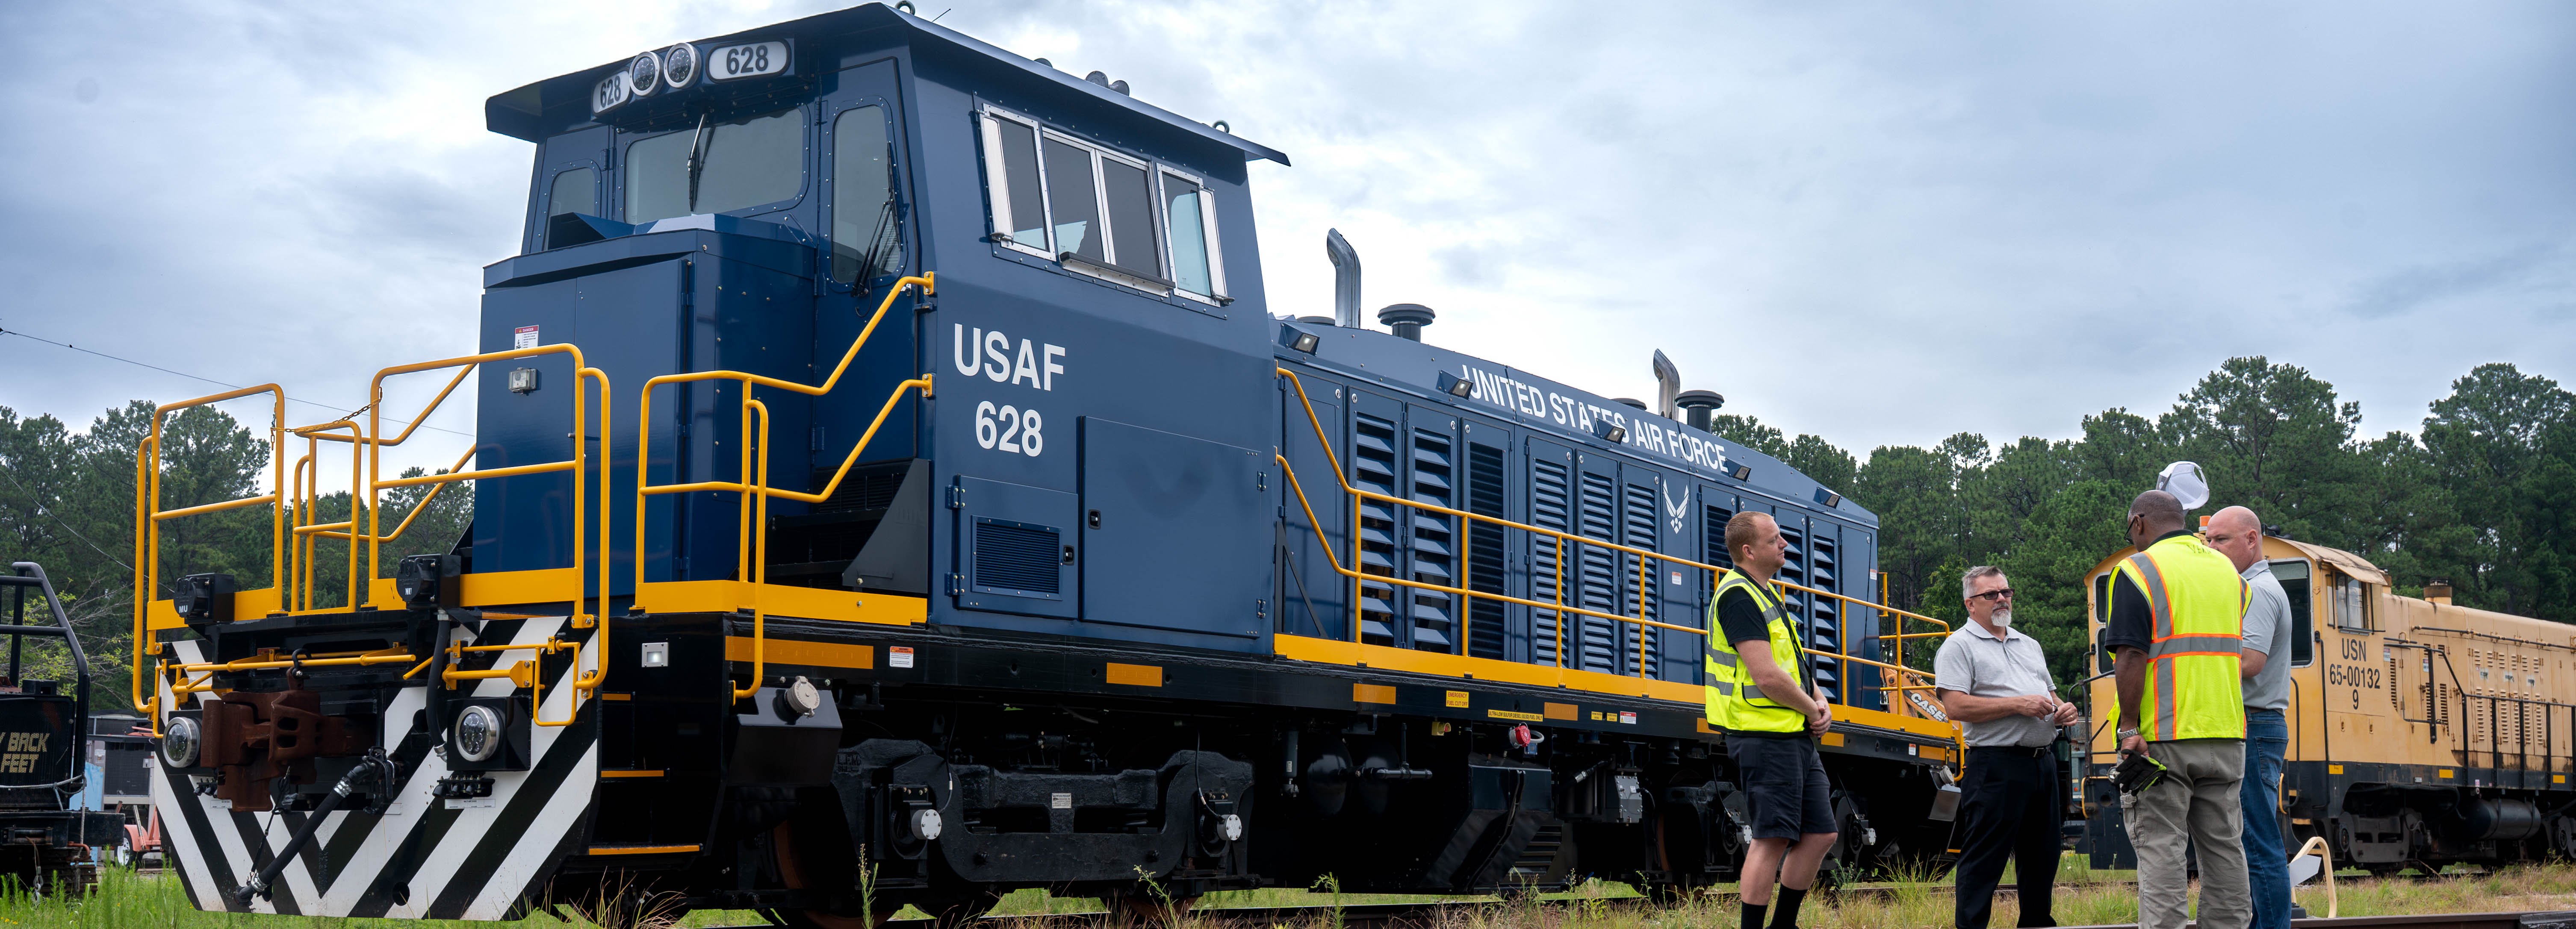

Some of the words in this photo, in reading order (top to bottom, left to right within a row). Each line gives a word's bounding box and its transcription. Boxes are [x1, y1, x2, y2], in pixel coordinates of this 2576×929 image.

[727, 45, 769, 75] 628
[600, 75, 621, 108] 628
[955, 323, 1065, 391] USAF
[976, 400, 1043, 457] 628
[1462, 364, 1546, 418] UNITED
[1635, 418, 1667, 455] AIR
[1667, 428, 1729, 473] FORCE
[179, 605, 188, 613] MU
[2342, 638, 2366, 662] USN
[2330, 663, 2380, 689] 65-00132
[1911, 693, 1947, 722] CASE
[2352, 689, 2359, 710] 9
[7, 732, 50, 752] BACK
[0, 753, 39, 773] FEET
